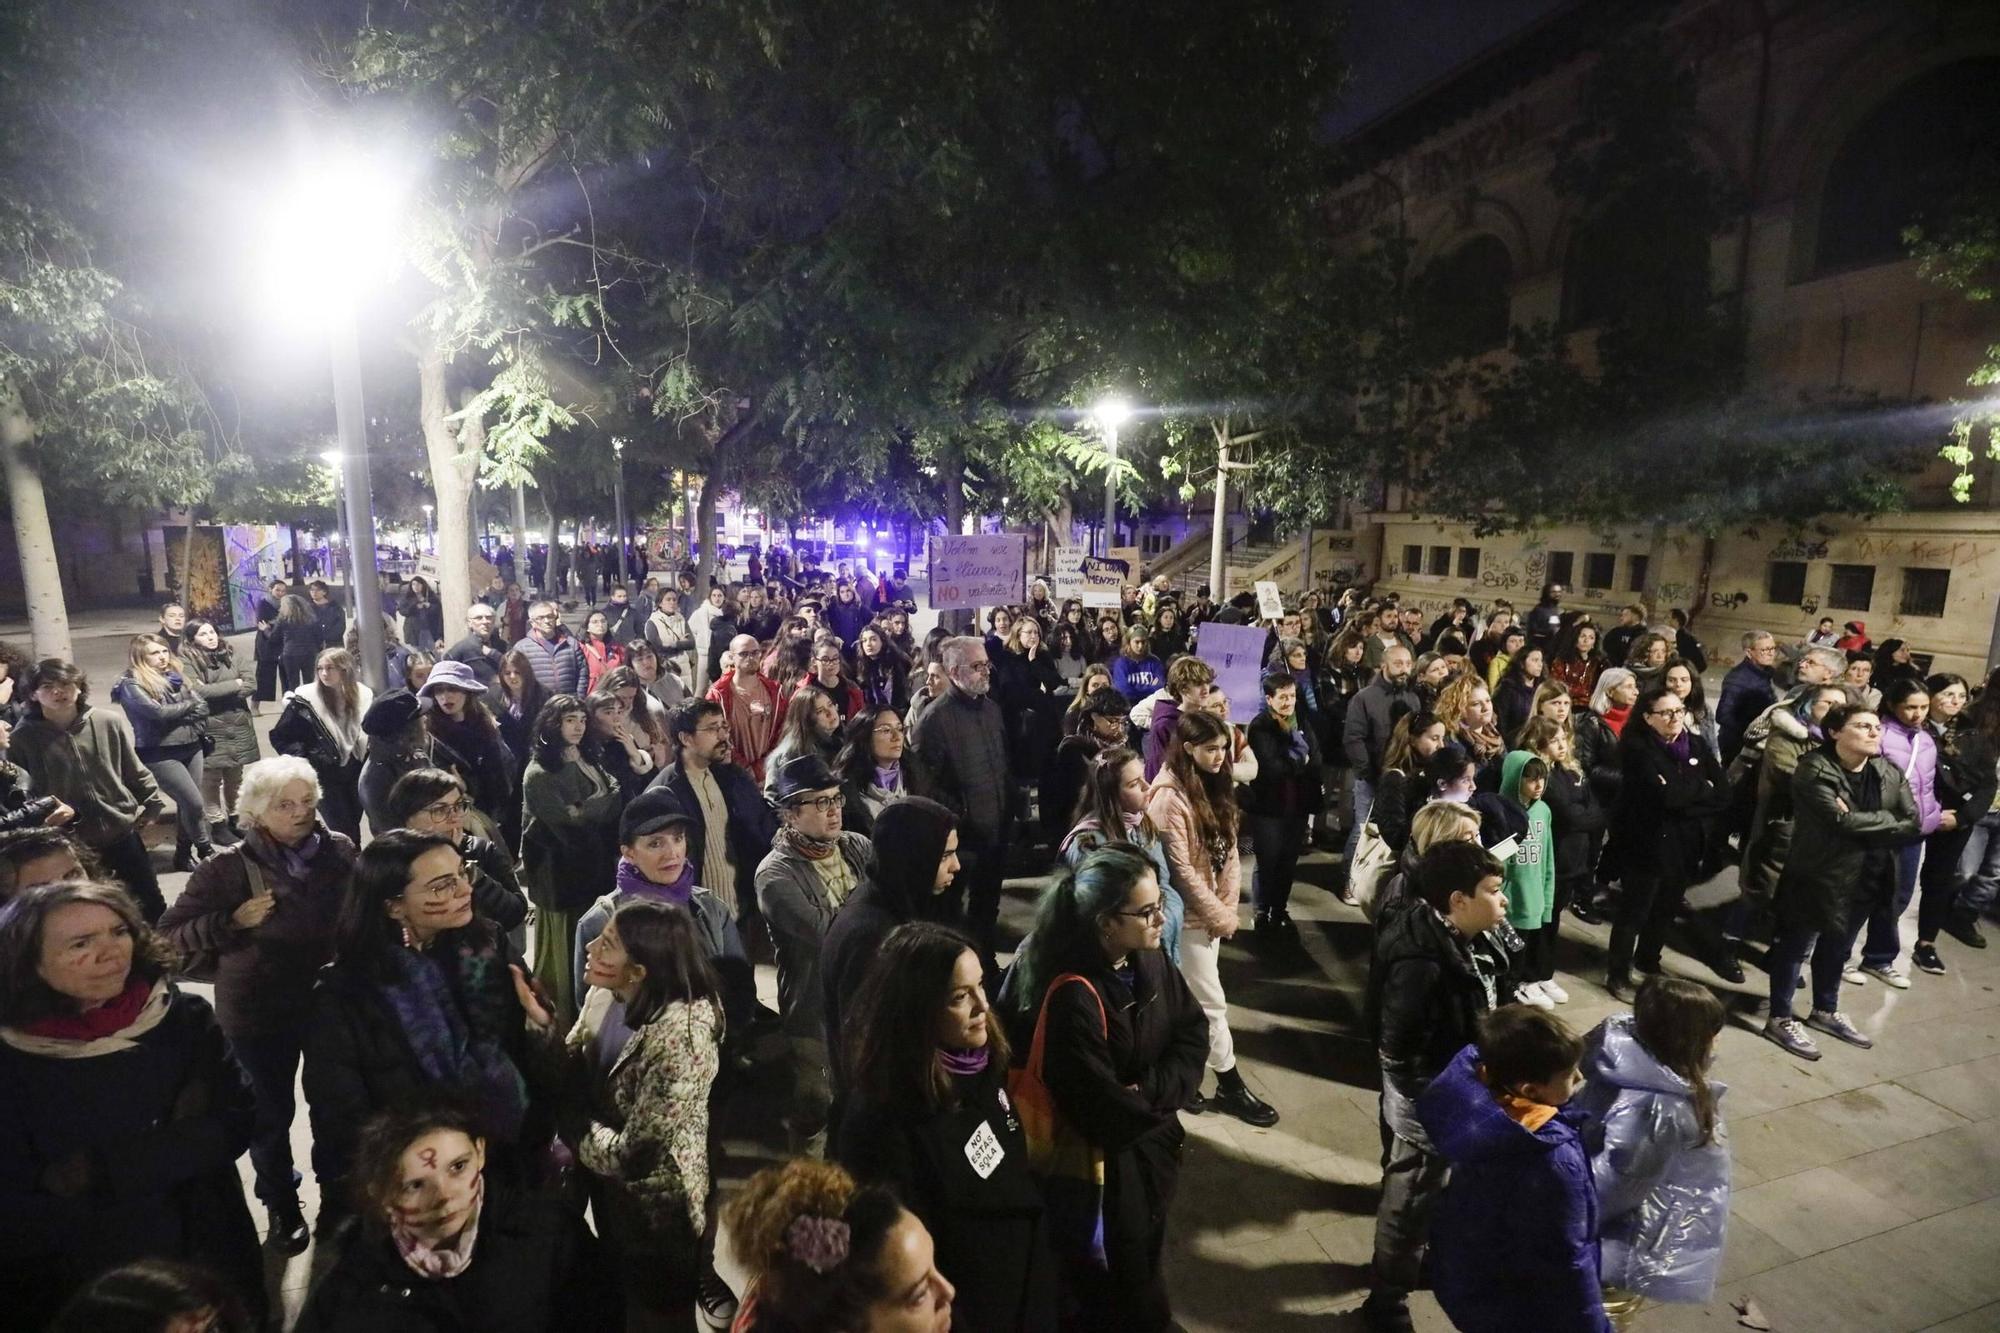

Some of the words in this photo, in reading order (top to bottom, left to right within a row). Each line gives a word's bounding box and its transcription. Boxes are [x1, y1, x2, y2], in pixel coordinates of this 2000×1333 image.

[1087, 561, 1102, 571] NI
[1087, 574, 1121, 587] MENYS!
[937, 585, 960, 601] NO
[1524, 819, 1545, 841] AP
